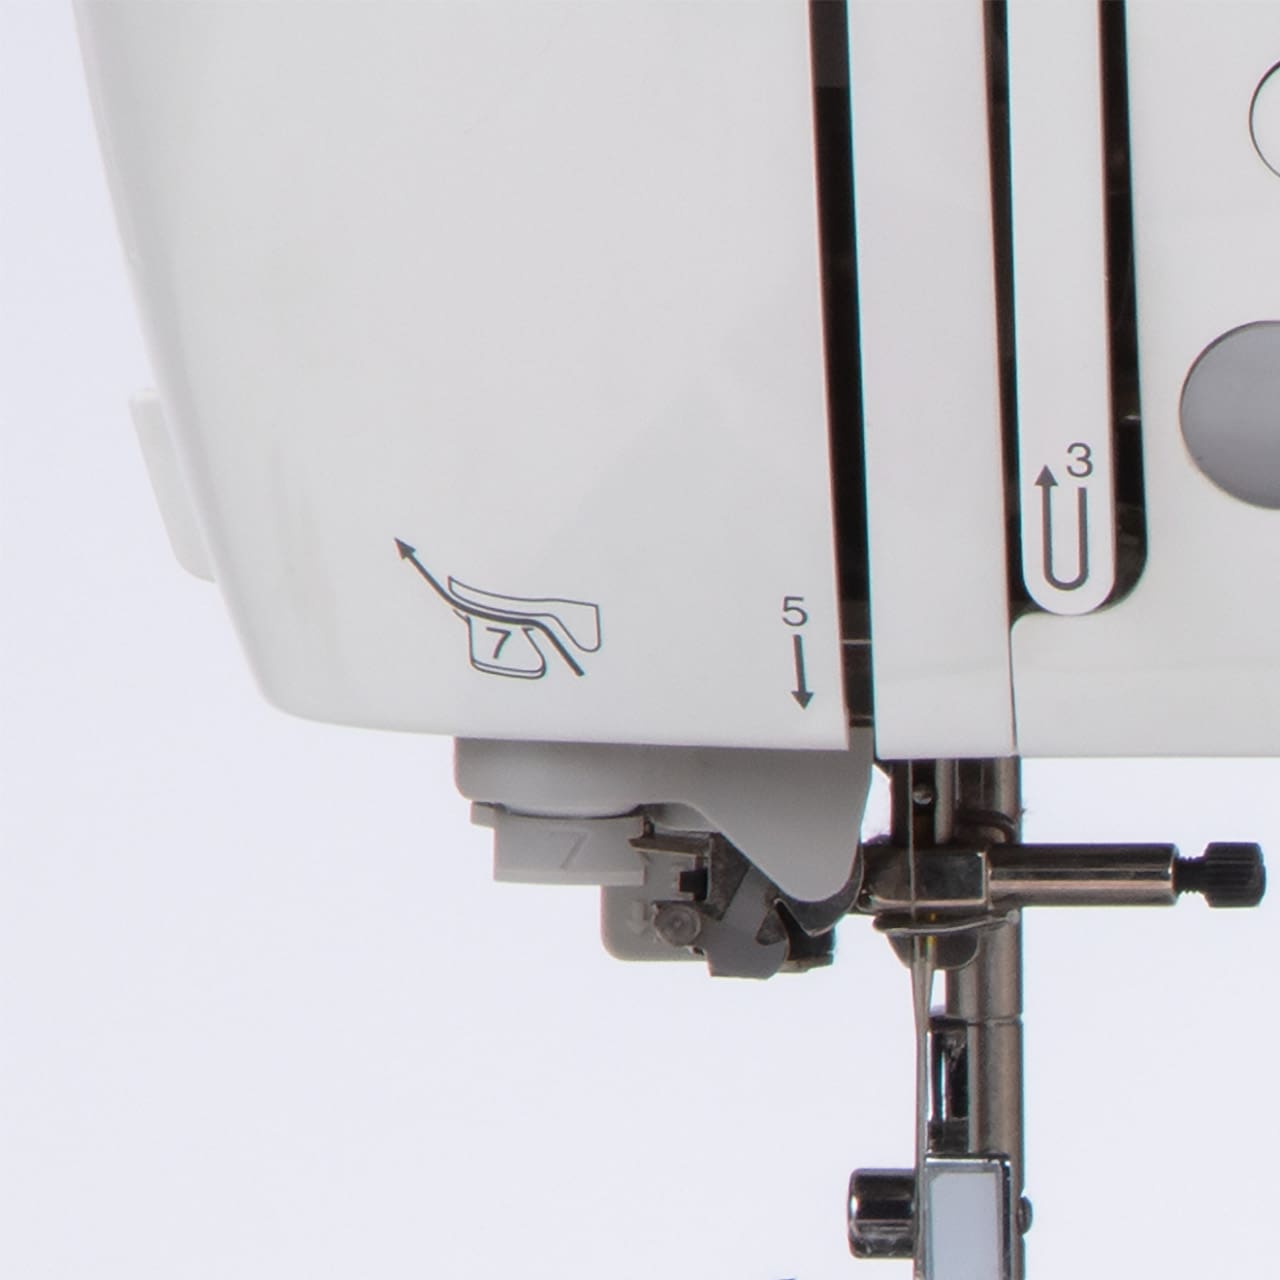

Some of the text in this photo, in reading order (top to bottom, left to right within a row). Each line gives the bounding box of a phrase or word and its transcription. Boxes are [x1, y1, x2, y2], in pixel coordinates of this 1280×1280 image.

[1066, 443, 1094, 478] 3
[782, 596, 808, 627] 5
[486, 627, 513, 660] 7
[547, 830, 592, 871] 7
